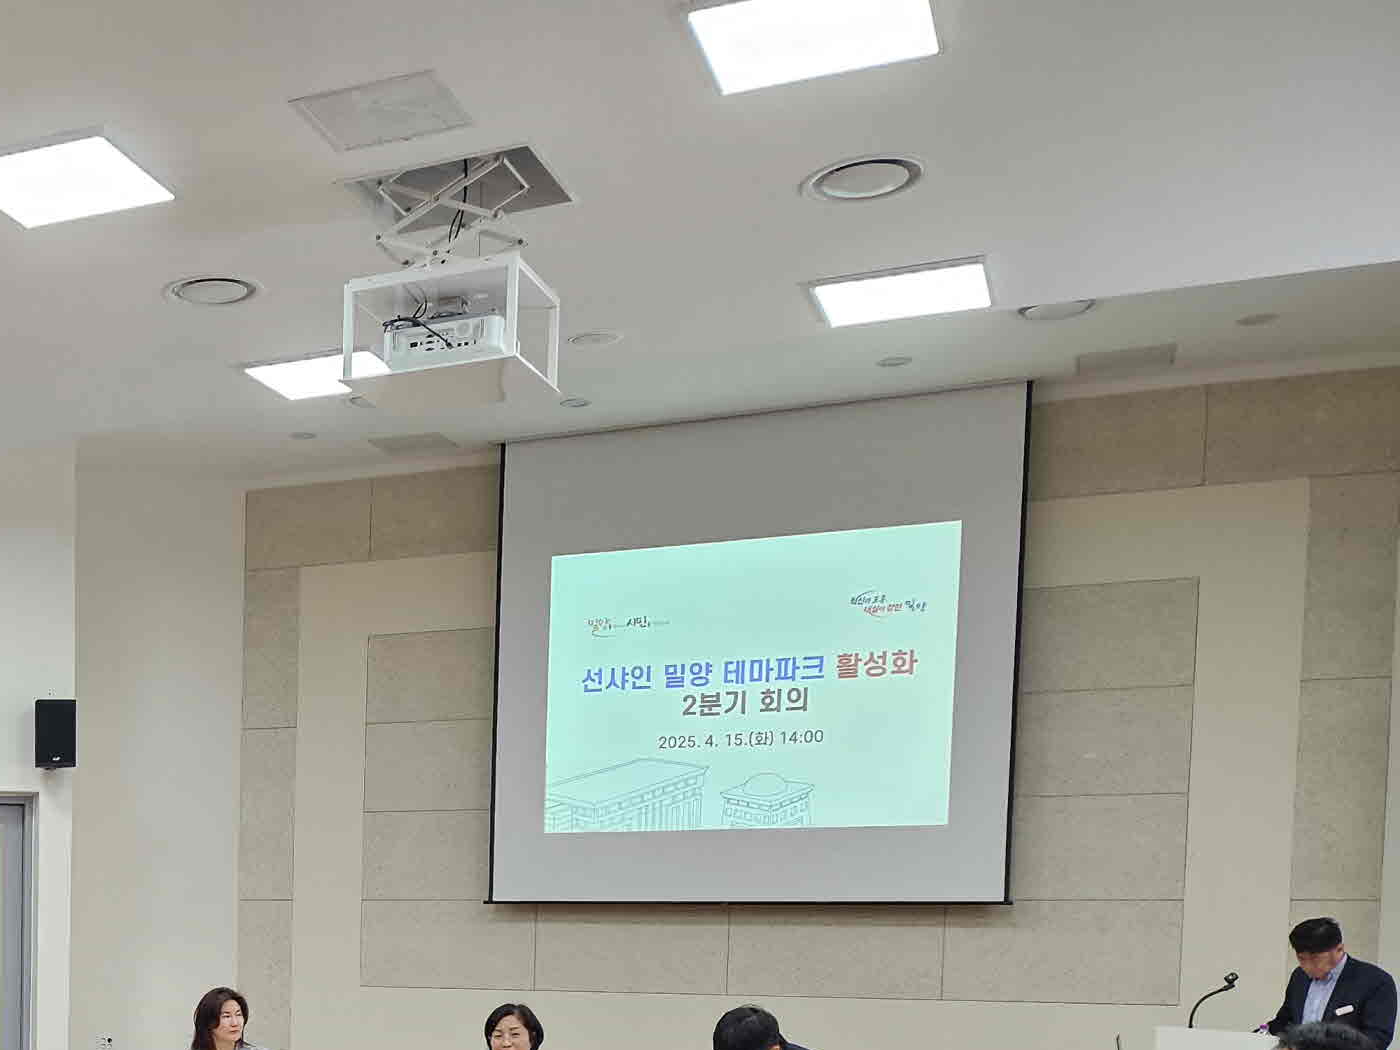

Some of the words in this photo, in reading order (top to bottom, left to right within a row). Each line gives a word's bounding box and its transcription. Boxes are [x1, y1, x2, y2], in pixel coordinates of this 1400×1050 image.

[582, 665, 652, 693] 선샤인
[664, 661, 713, 689] 밀양
[723, 655, 826, 685] 테마파크
[836, 649, 919, 680] 활성화
[682, 690, 747, 716] 2분기
[759, 686, 809, 713] 회의
[658, 734, 701, 750] 2025.
[705, 734, 719, 748] 4.
[725, 730, 775, 748] 15.(화)
[780, 729, 824, 745] 14:00
